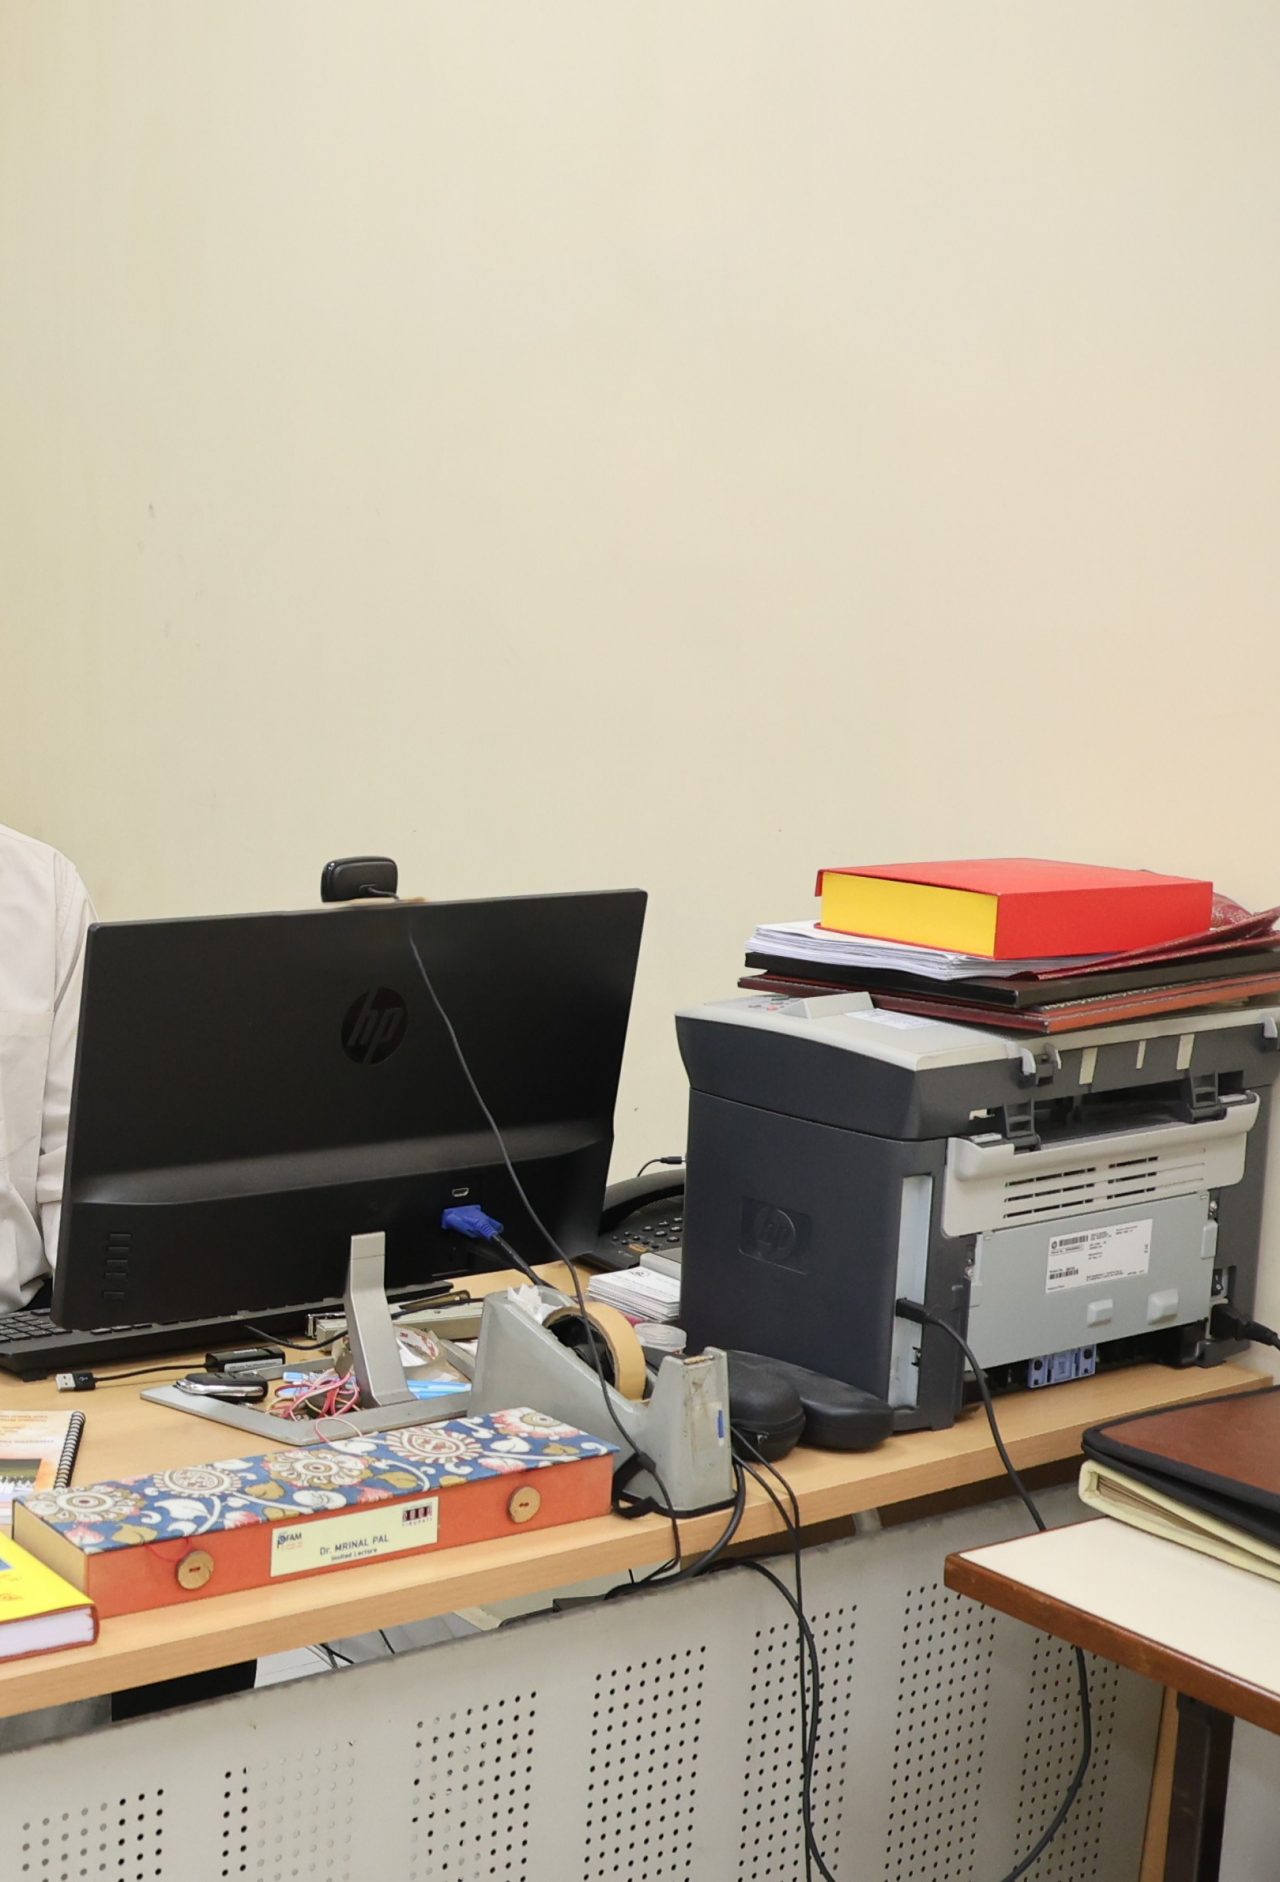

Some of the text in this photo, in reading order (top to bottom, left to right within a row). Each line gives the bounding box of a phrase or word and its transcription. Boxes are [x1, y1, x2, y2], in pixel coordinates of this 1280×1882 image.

[320, 1535, 389, 1556] Dr. MRINAL PAL
